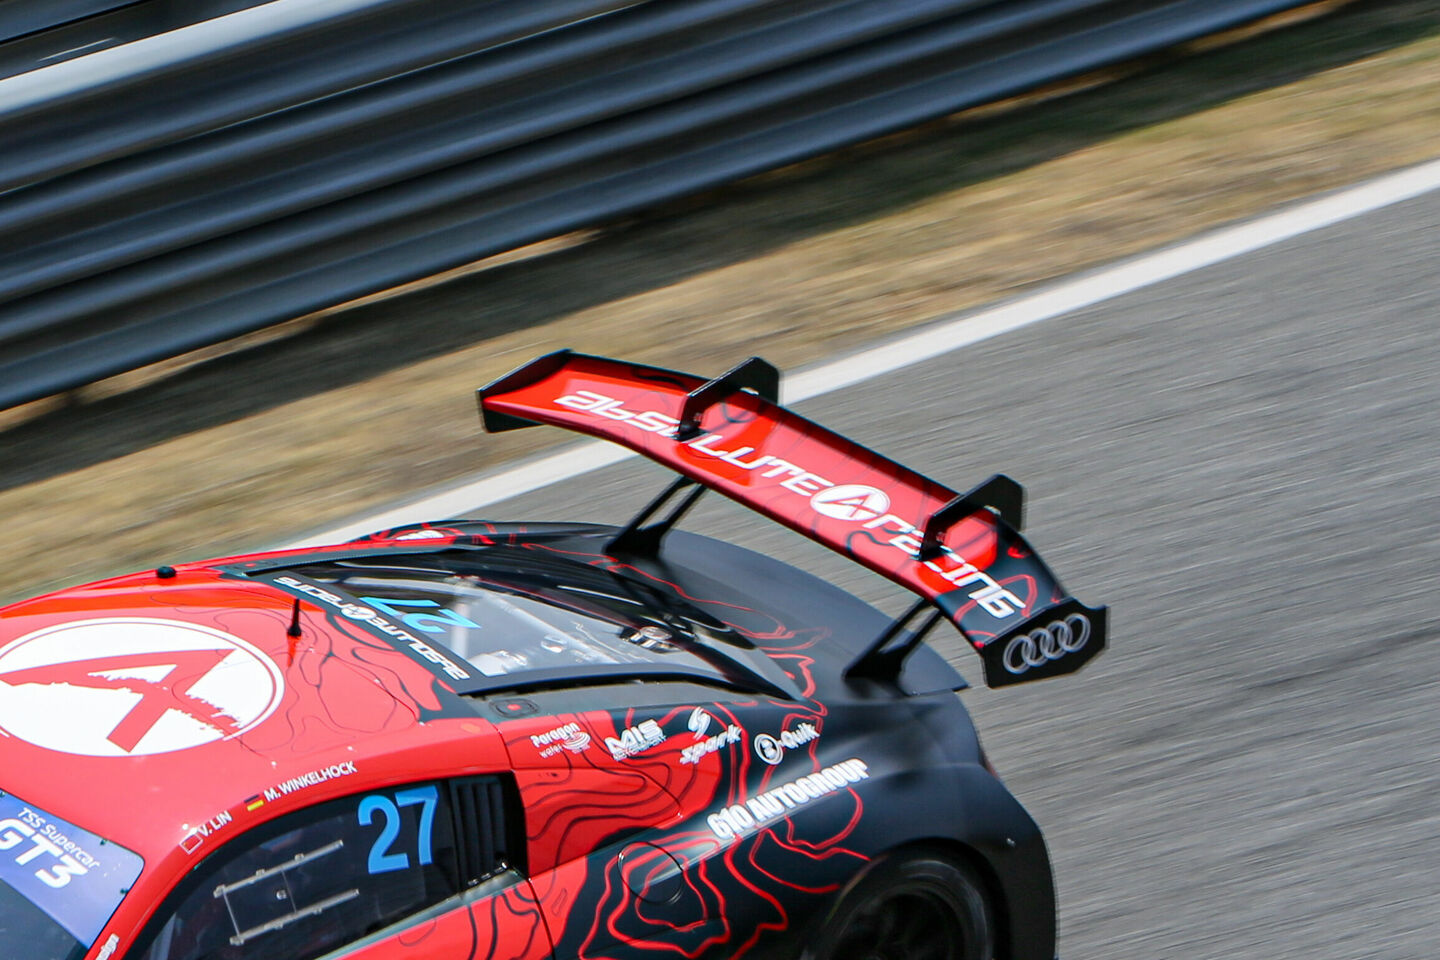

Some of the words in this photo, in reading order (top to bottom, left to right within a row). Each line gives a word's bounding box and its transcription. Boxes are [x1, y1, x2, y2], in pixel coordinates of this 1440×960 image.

[553, 390, 835, 497] abSLUTE
[359, 596, 482, 634] 27
[263, 785, 280, 802] M.
[277, 761, 357, 796] WINKELHOCK
[707, 804, 756, 840] 610
[745, 758, 871, 823] AUTOGROUP
[18, 807, 47, 829] TSS
[40, 823, 100, 869] Supercar
[197, 822, 214, 838] V.
[210, 810, 233, 832] LIN
[357, 785, 440, 875] 27
